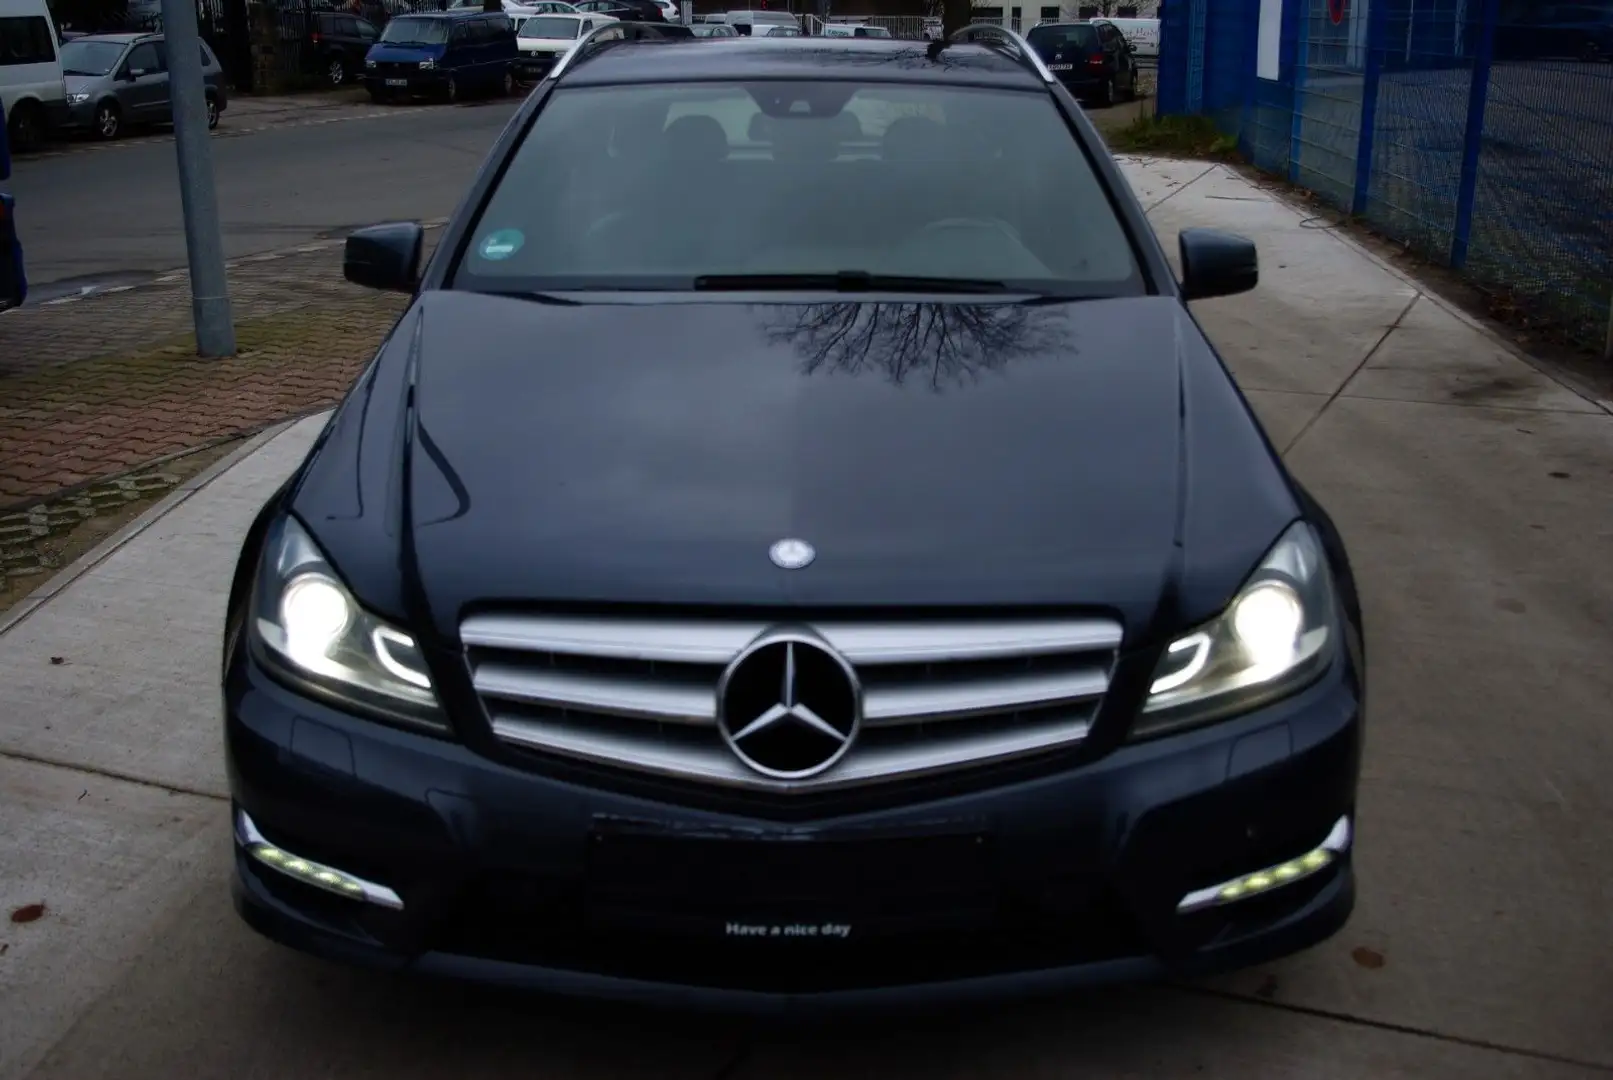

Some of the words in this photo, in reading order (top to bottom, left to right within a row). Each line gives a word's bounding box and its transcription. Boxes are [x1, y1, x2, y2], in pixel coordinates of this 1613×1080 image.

[726, 922, 767, 936] Have
[769, 925, 781, 936] a
[783, 923, 817, 936] nice
[820, 922, 851, 938] day
